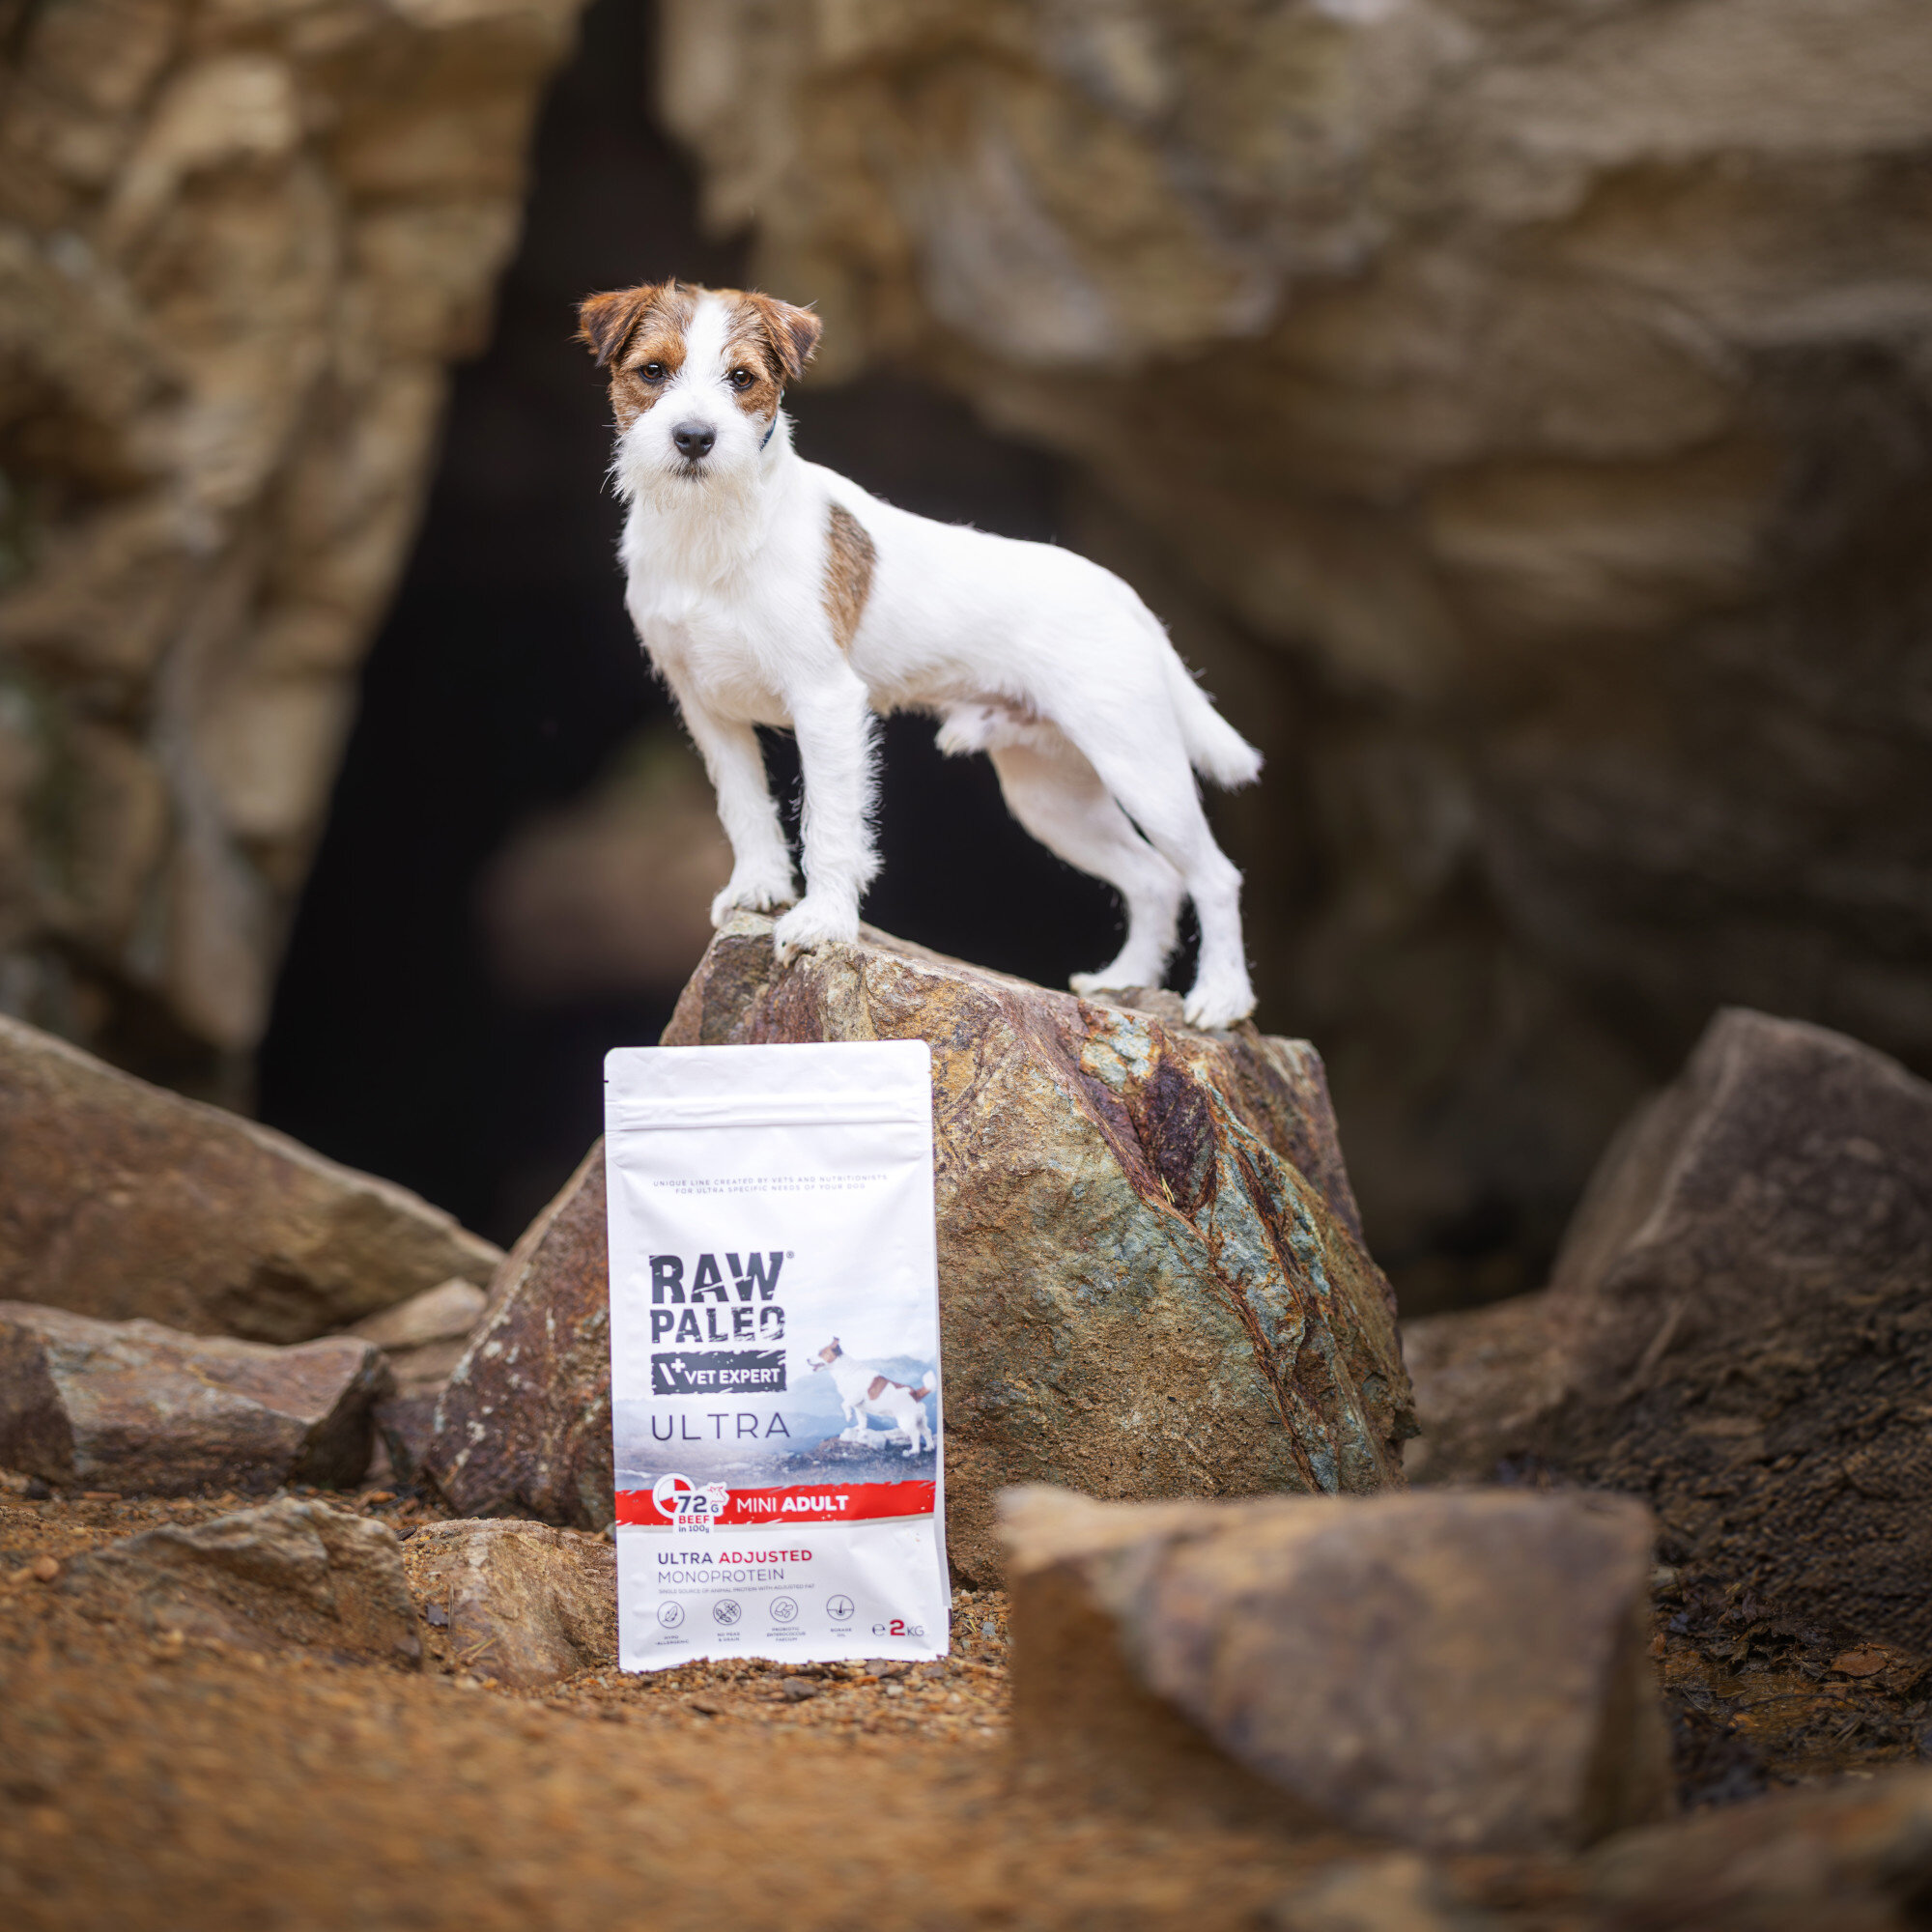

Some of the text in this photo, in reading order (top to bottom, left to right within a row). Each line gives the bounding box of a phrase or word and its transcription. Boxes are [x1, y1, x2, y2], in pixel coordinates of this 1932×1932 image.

[650, 1306, 785, 1343] PALEO
[684, 1369, 781, 1384] VET EXPERT
[652, 1412, 790, 1441] ULTRA
[737, 1495, 849, 1514] MINI ADULT
[679, 1515, 710, 1524] BEEF
[658, 1549, 812, 1565] ULTRA ADJUSTED
[658, 1568, 784, 1584] MONOPROTEIN
